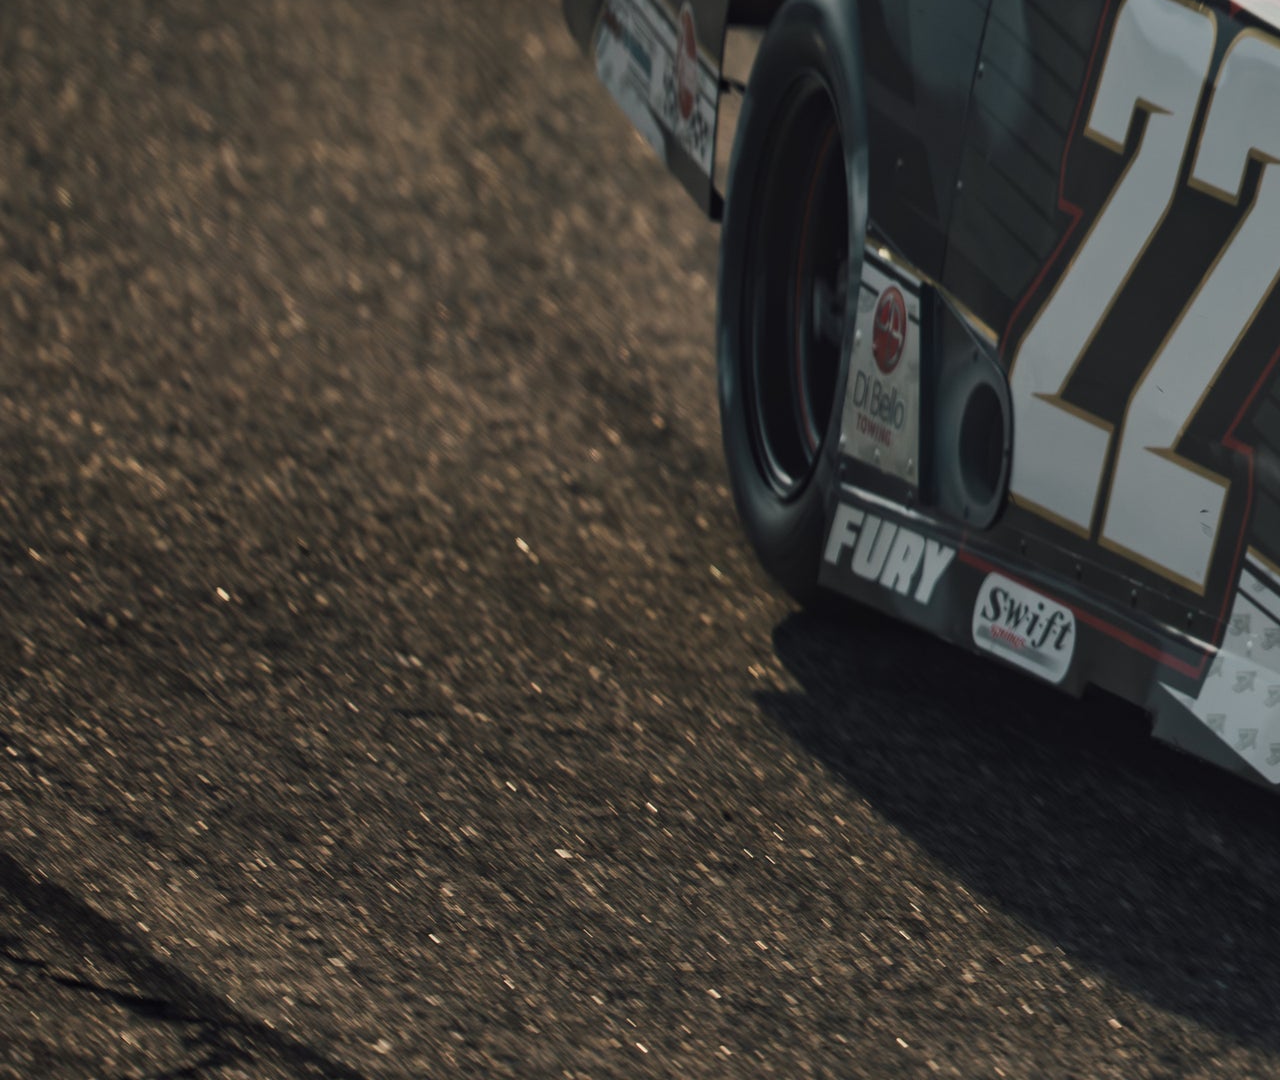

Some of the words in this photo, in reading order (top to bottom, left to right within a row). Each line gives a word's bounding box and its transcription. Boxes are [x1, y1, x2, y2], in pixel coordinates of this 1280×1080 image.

[855, 412, 892, 448] TOWING
[870, 379, 905, 430] Bello
[824, 501, 956, 605] FURY
